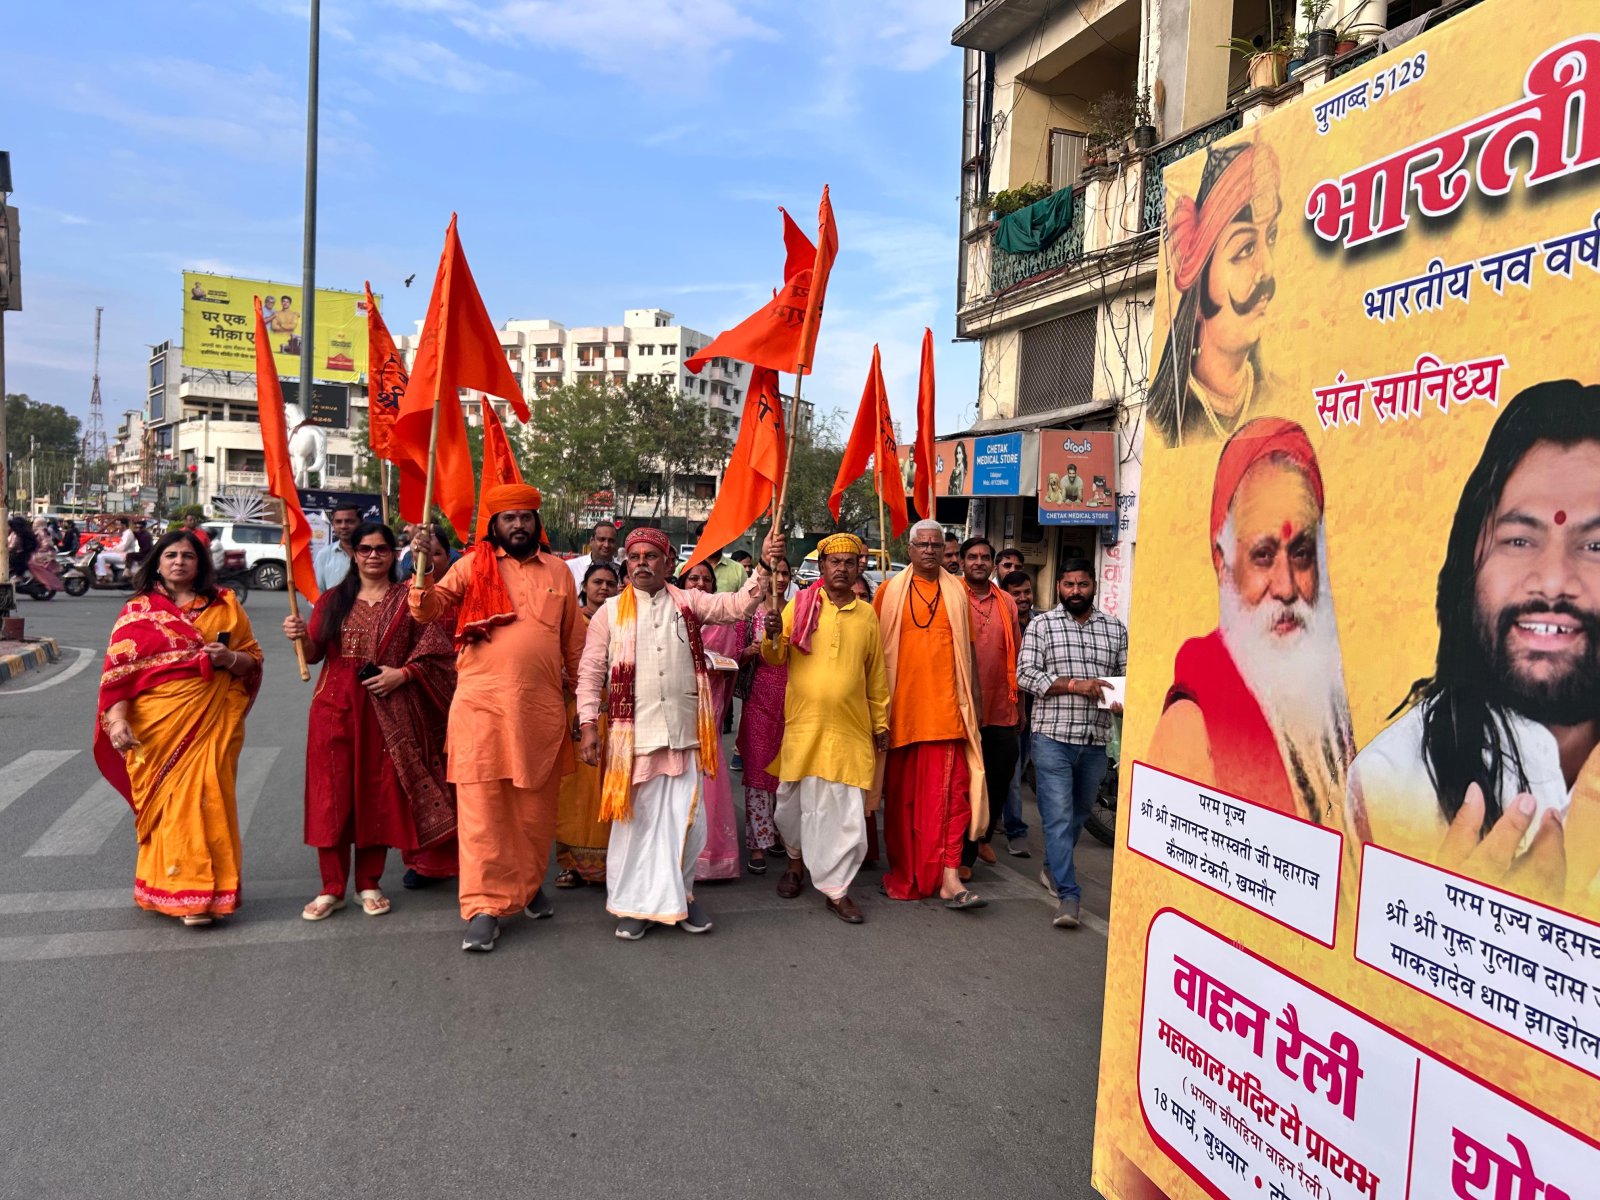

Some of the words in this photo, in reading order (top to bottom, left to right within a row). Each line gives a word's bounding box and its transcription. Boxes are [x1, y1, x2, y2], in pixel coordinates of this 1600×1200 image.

[1315, 82, 1369, 132] युगाब्द
[1372, 53, 1426, 99] 5128
[201, 311, 220, 323] घर
[1363, 259, 1474, 320] भारतीय
[1480, 247, 1537, 292] नव
[245, 332, 255, 344] ए
[1315, 373, 1365, 427] संत
[1370, 355, 1504, 419] सानिध्य
[976, 455, 999, 466] MEDICAL
[1000, 453, 1018, 464] STORE
[986, 443, 1008, 454] CHETAK
[1063, 437, 1092, 453] drools
[1141, 799, 1153, 819] श्री
[1155, 805, 1168, 825] श्री
[1210, 829, 1251, 861] सरस्वती
[1254, 845, 1270, 869] जी
[1273, 855, 1320, 890] महाराज
[1199, 793, 1220, 816] परम
[1223, 802, 1246, 827] पूज्य
[1166, 838, 1198, 869] कैलाश
[1235, 873, 1276, 906] खमनौर
[1445, 883, 1484, 916] परम
[1488, 899, 1532, 935] पूज्य
[1385, 899, 1408, 927] श्री
[1413, 911, 1437, 940] श्री
[1480, 940, 1539, 984] गुलाब
[1543, 966, 1588, 1004] दास
[1390, 942, 1475, 1000] माकड़ादेव
[1480, 985, 1520, 1020] धाम
[1173, 953, 1270, 1058] वाहन
[1275, 1002, 1364, 1122] रैली
[1154, 1087, 1168, 1113] 18
[1203, 1126, 1249, 1182] बुधवार
[1158, 1018, 1225, 1086] महाकाल
[1228, 1068, 1279, 1127] मंदिर
[1280, 1103, 1302, 1147] से
[1305, 1125, 1381, 1200] प्रारम्भ
[1265, 1142, 1296, 1179] वाहन
[1452, 1126, 1571, 1200] शो
